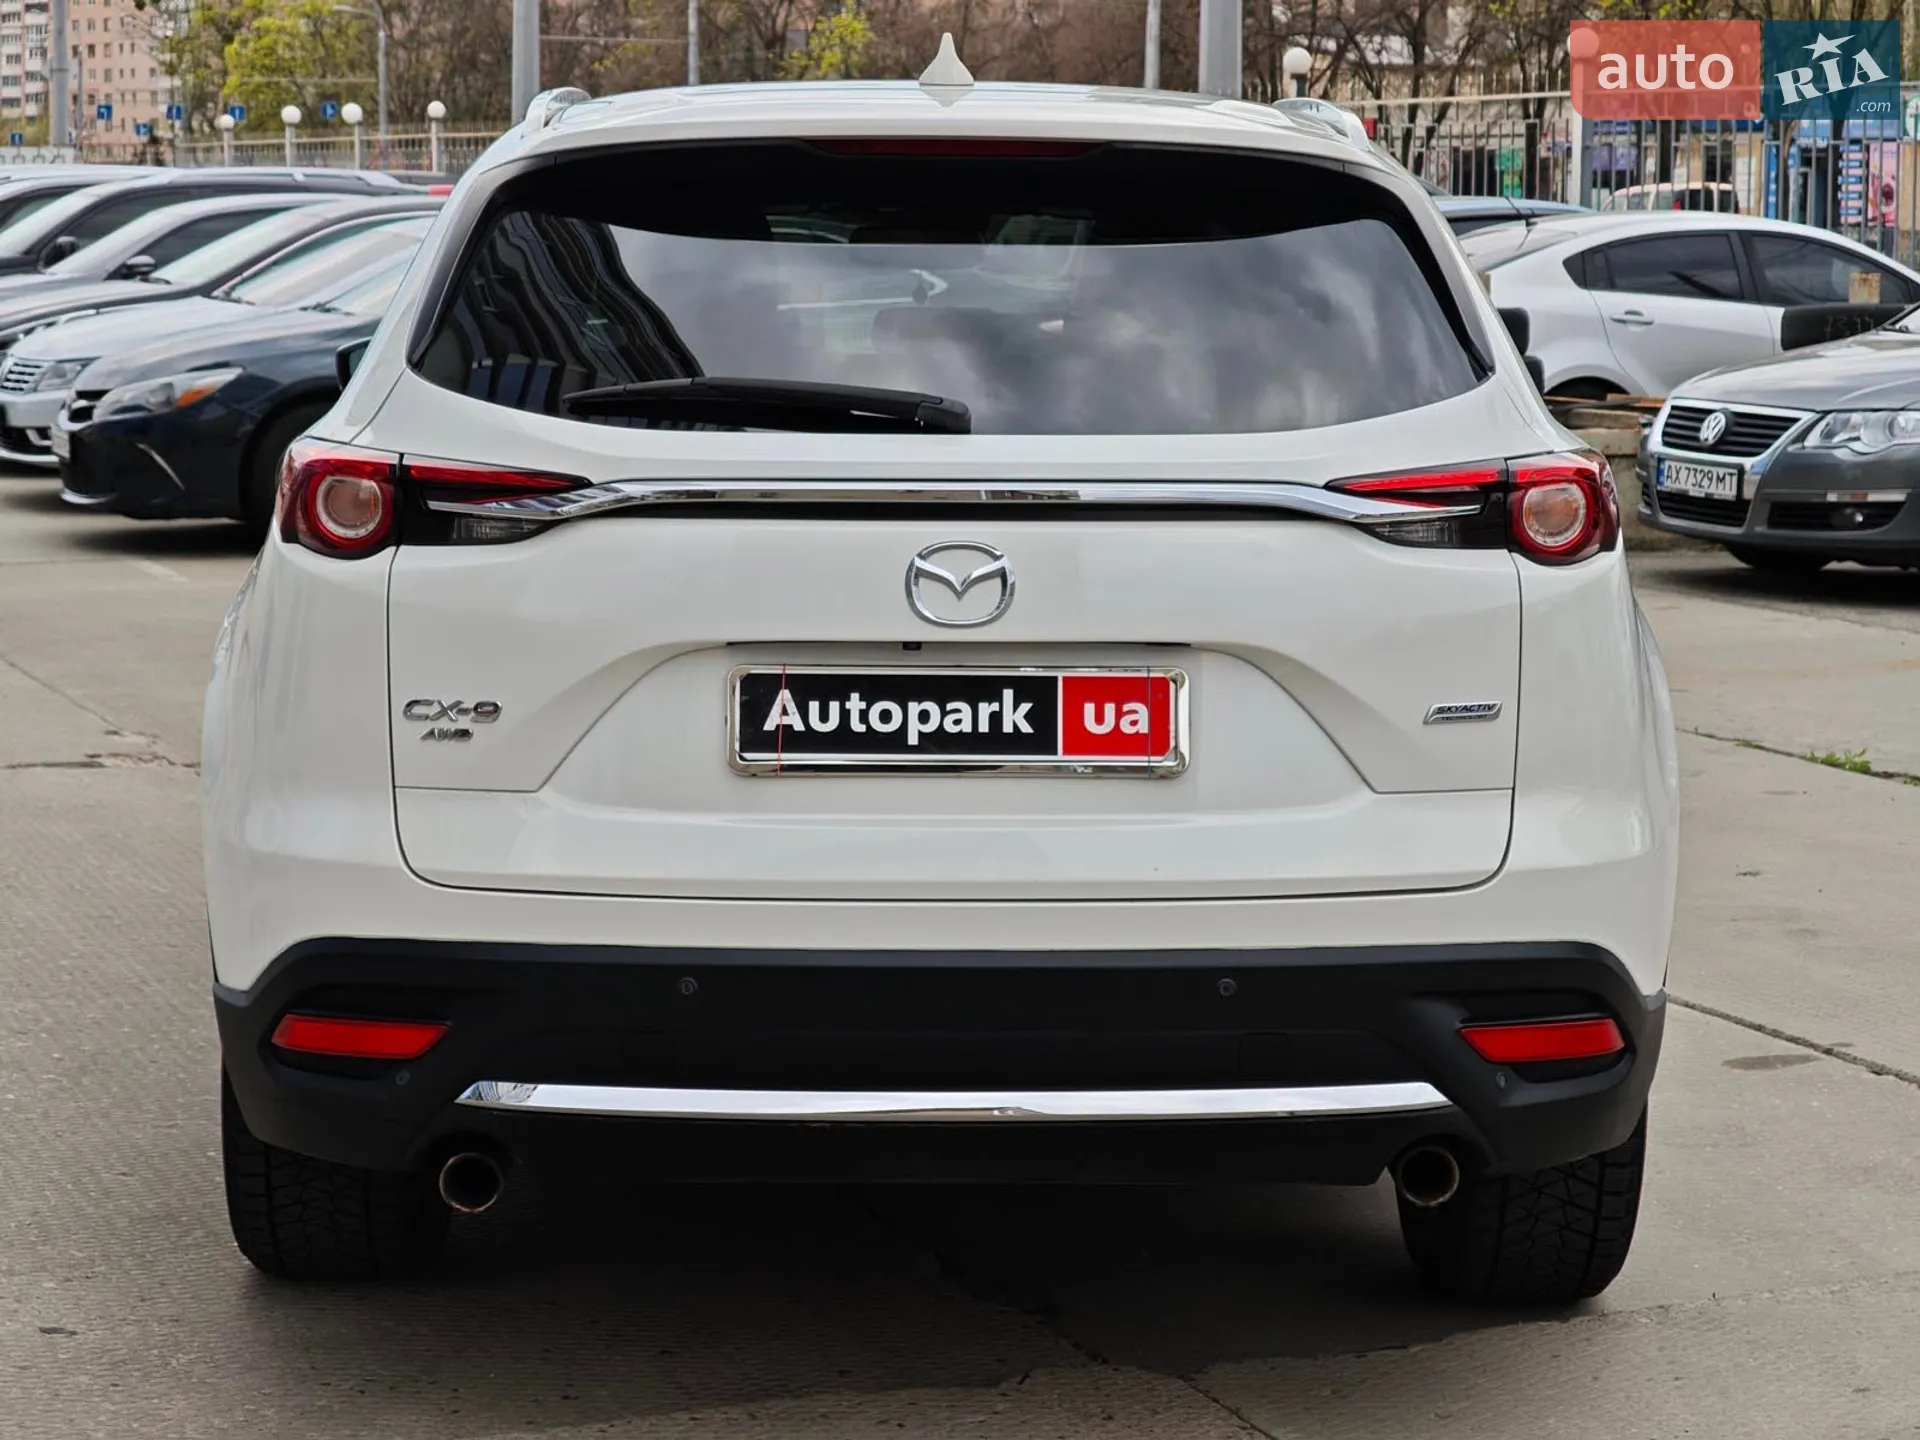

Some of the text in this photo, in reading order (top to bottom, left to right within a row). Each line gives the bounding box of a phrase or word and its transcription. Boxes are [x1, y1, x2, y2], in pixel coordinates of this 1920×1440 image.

[1666, 464, 1737, 492] AX 7329 MT
[403, 699, 502, 723] CX-9
[763, 688, 1149, 746] Autopark ua
[1436, 703, 1496, 714] SKYACTIV
[420, 727, 474, 741] AWD
